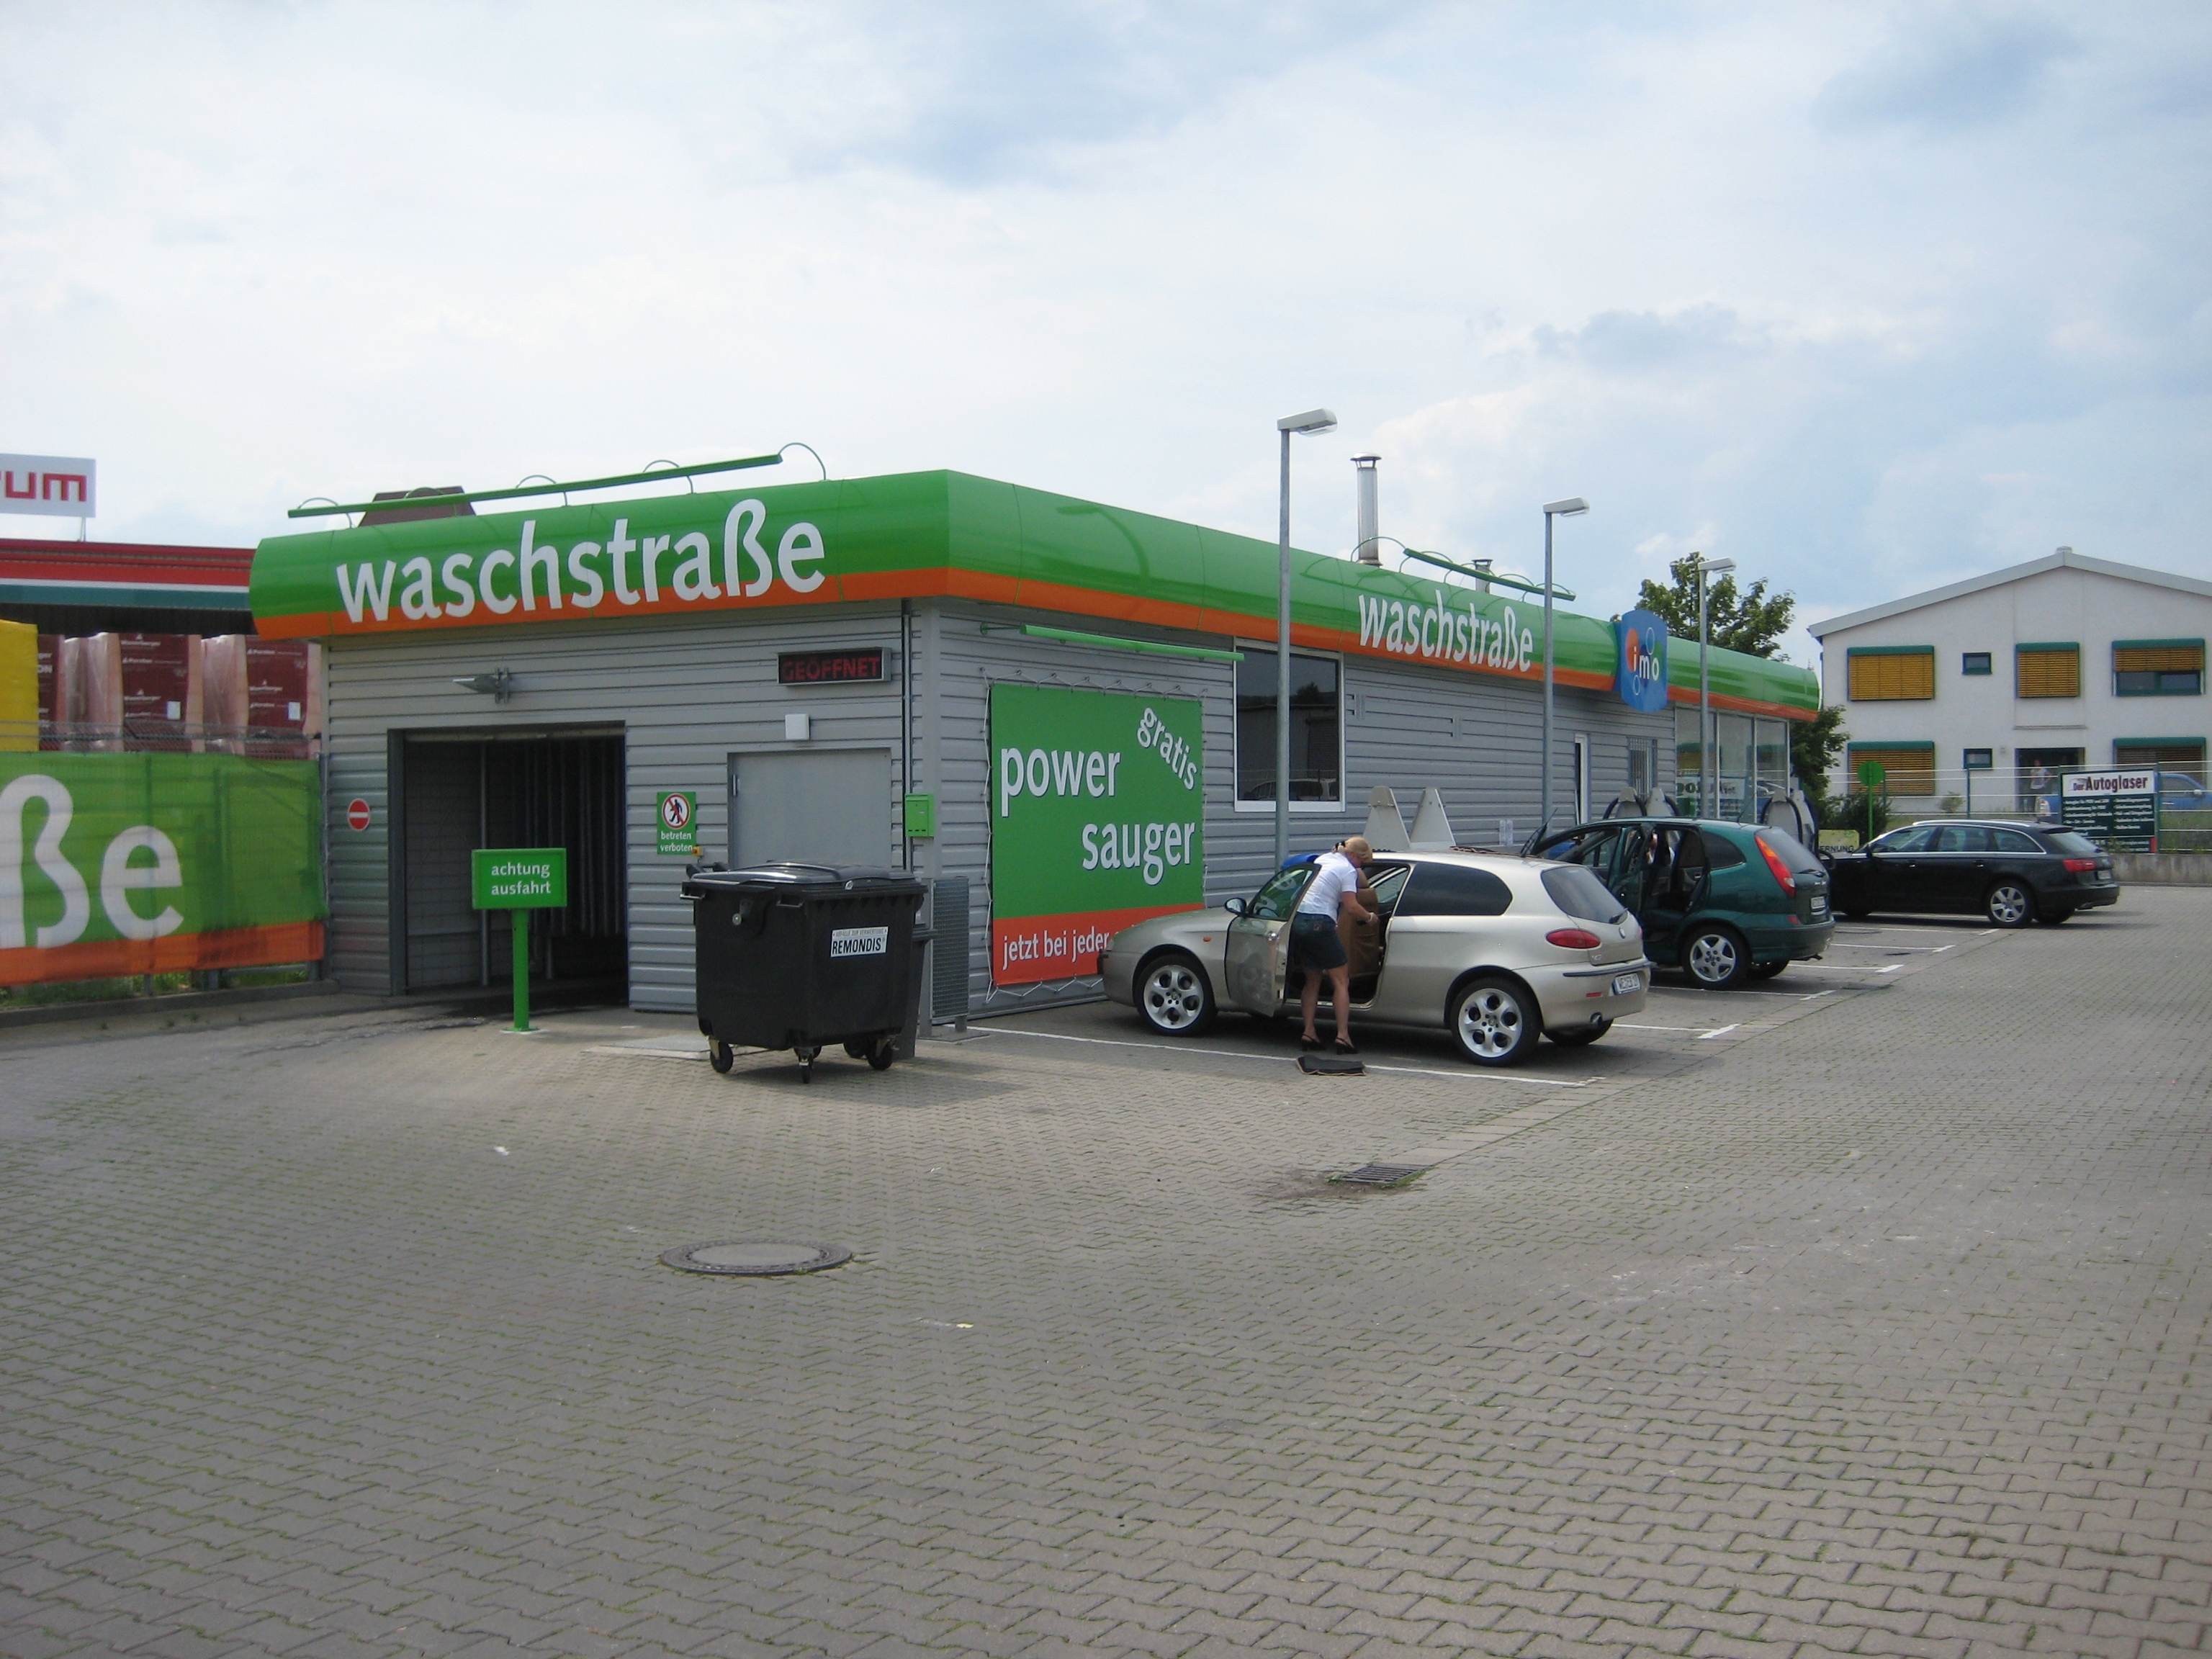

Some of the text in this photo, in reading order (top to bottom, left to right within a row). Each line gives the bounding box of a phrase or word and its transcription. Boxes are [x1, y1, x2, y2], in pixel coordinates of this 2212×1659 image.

[0, 471, 86, 502] um
[337, 498, 825, 623] waschstraße
[1358, 589, 1533, 673] waschstraße
[783, 656, 881, 680] GEÖFFNET
[1633, 645, 1660, 681] imo
[1136, 707, 1197, 790] gratis
[1001, 747, 1121, 817] power
[2085, 774, 2148, 793] Autoglaser
[660, 830, 692, 840] betreten
[660, 842, 693, 852] verboten
[1082, 822, 1195, 886] sauger
[491, 862, 551, 878] achtung
[491, 880, 552, 896] ausfahrt
[832, 938, 882, 955] REMONDIS
[1002, 925, 1110, 971] jetzt bei jeder
